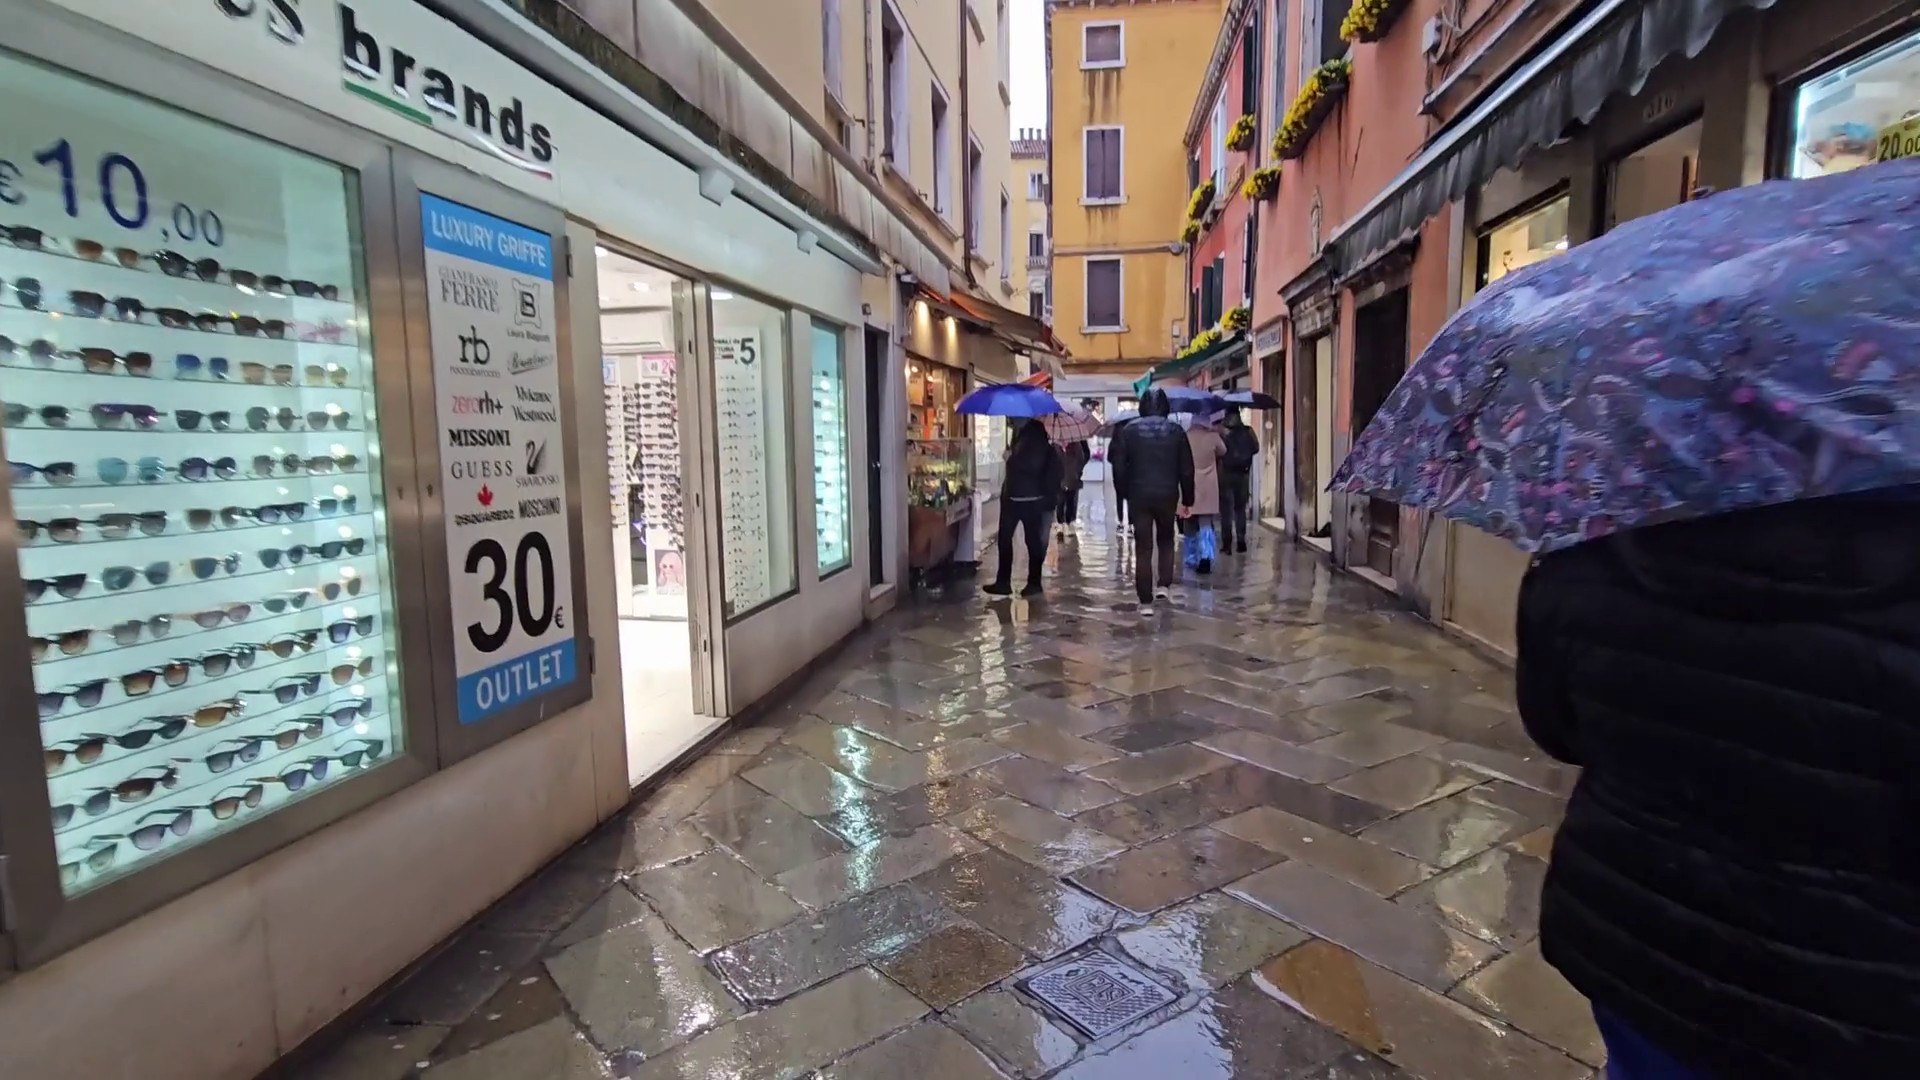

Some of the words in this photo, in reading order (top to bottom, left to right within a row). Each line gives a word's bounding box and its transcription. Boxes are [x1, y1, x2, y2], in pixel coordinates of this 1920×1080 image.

[339, 4, 556, 162] brands
[431, 210, 493, 253] LUXURY
[497, 233, 547, 268] GRIFFE
[458, 325, 490, 365] rb
[740, 337, 755, 366] 5
[448, 428, 511, 447] MISSONI
[451, 460, 513, 479] GUESS
[476, 651, 563, 711] OUTLET
